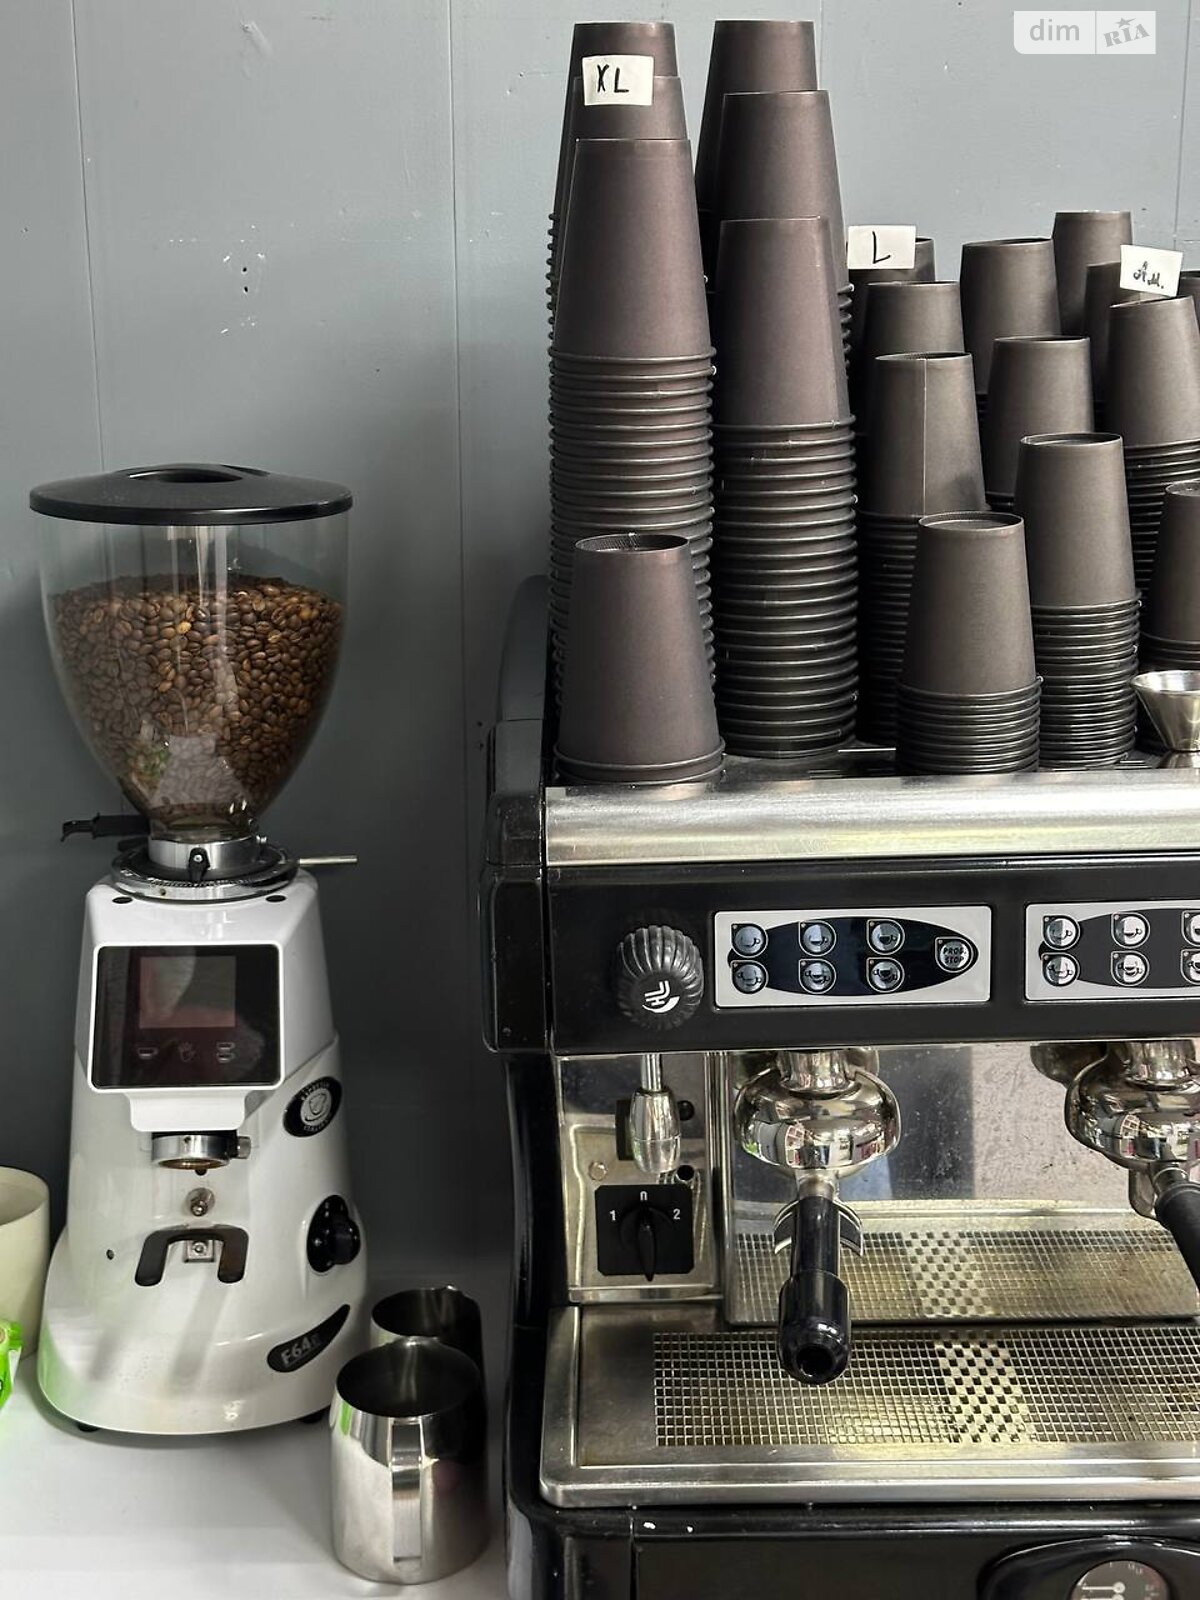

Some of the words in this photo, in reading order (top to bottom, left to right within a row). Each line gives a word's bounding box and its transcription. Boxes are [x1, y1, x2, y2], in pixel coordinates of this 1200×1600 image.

[597, 64, 630, 93] XL
[872, 231, 891, 264] L
[609, 1209, 616, 1221] 1
[673, 1208, 681, 1220] 2
